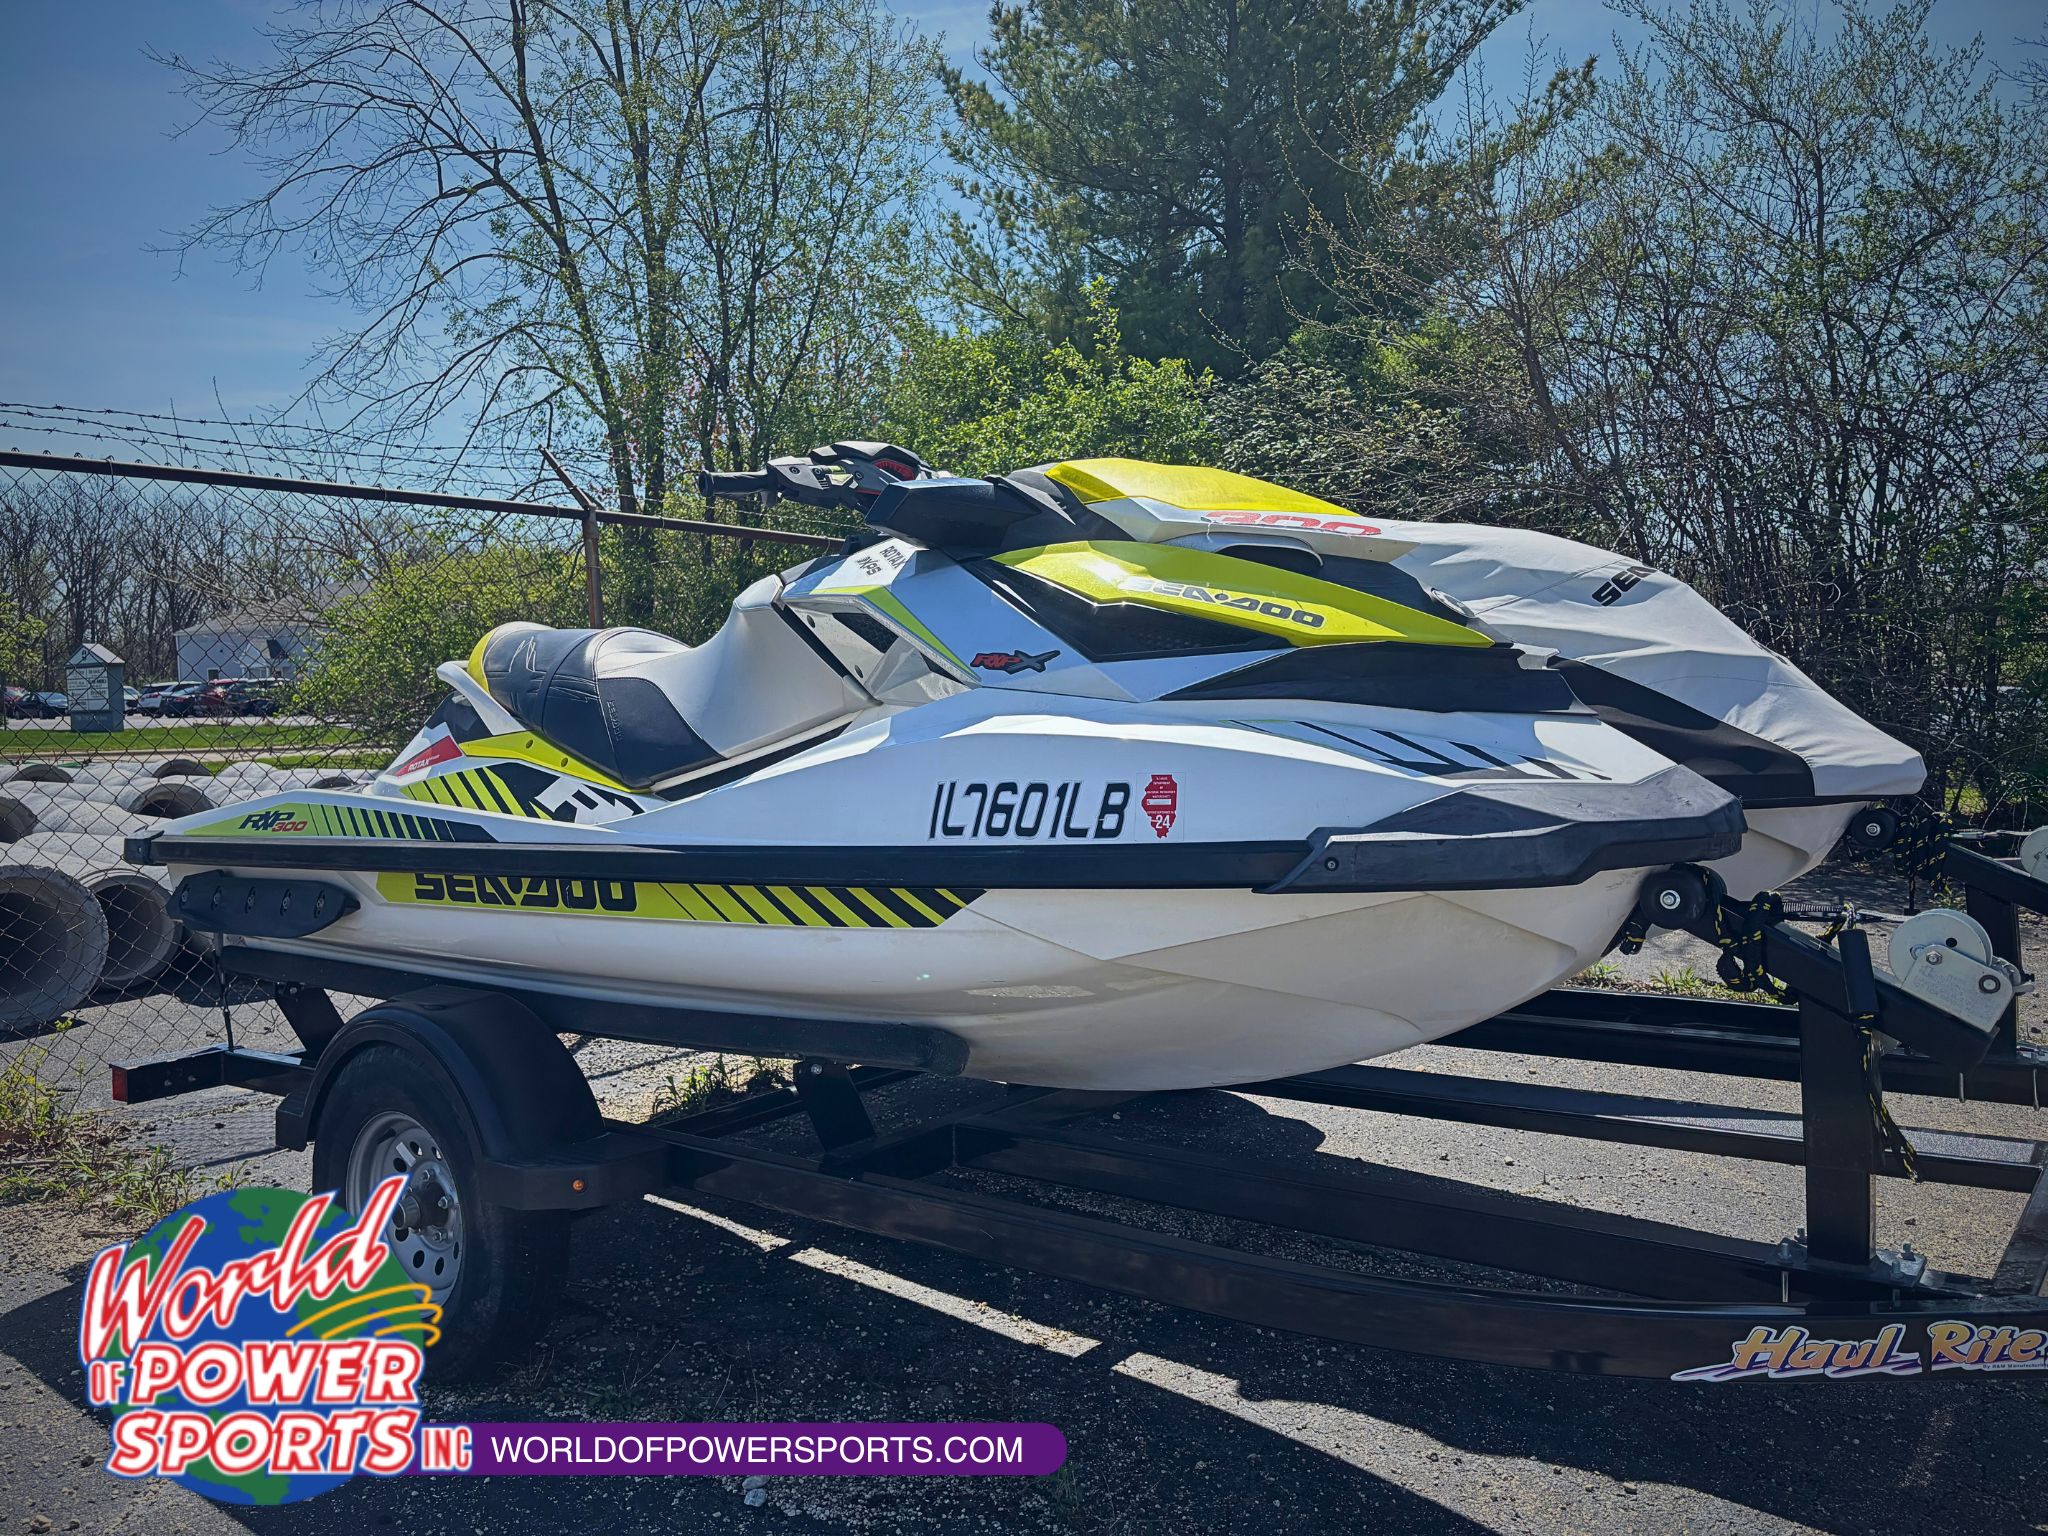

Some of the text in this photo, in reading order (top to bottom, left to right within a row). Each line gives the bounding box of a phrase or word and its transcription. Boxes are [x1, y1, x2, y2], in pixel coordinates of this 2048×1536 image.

[238, 810, 295, 831] RXP
[272, 820, 308, 833] 300
[929, 781, 1130, 839] IL7601LB
[1733, 1321, 2044, 1372] Haul Rite
